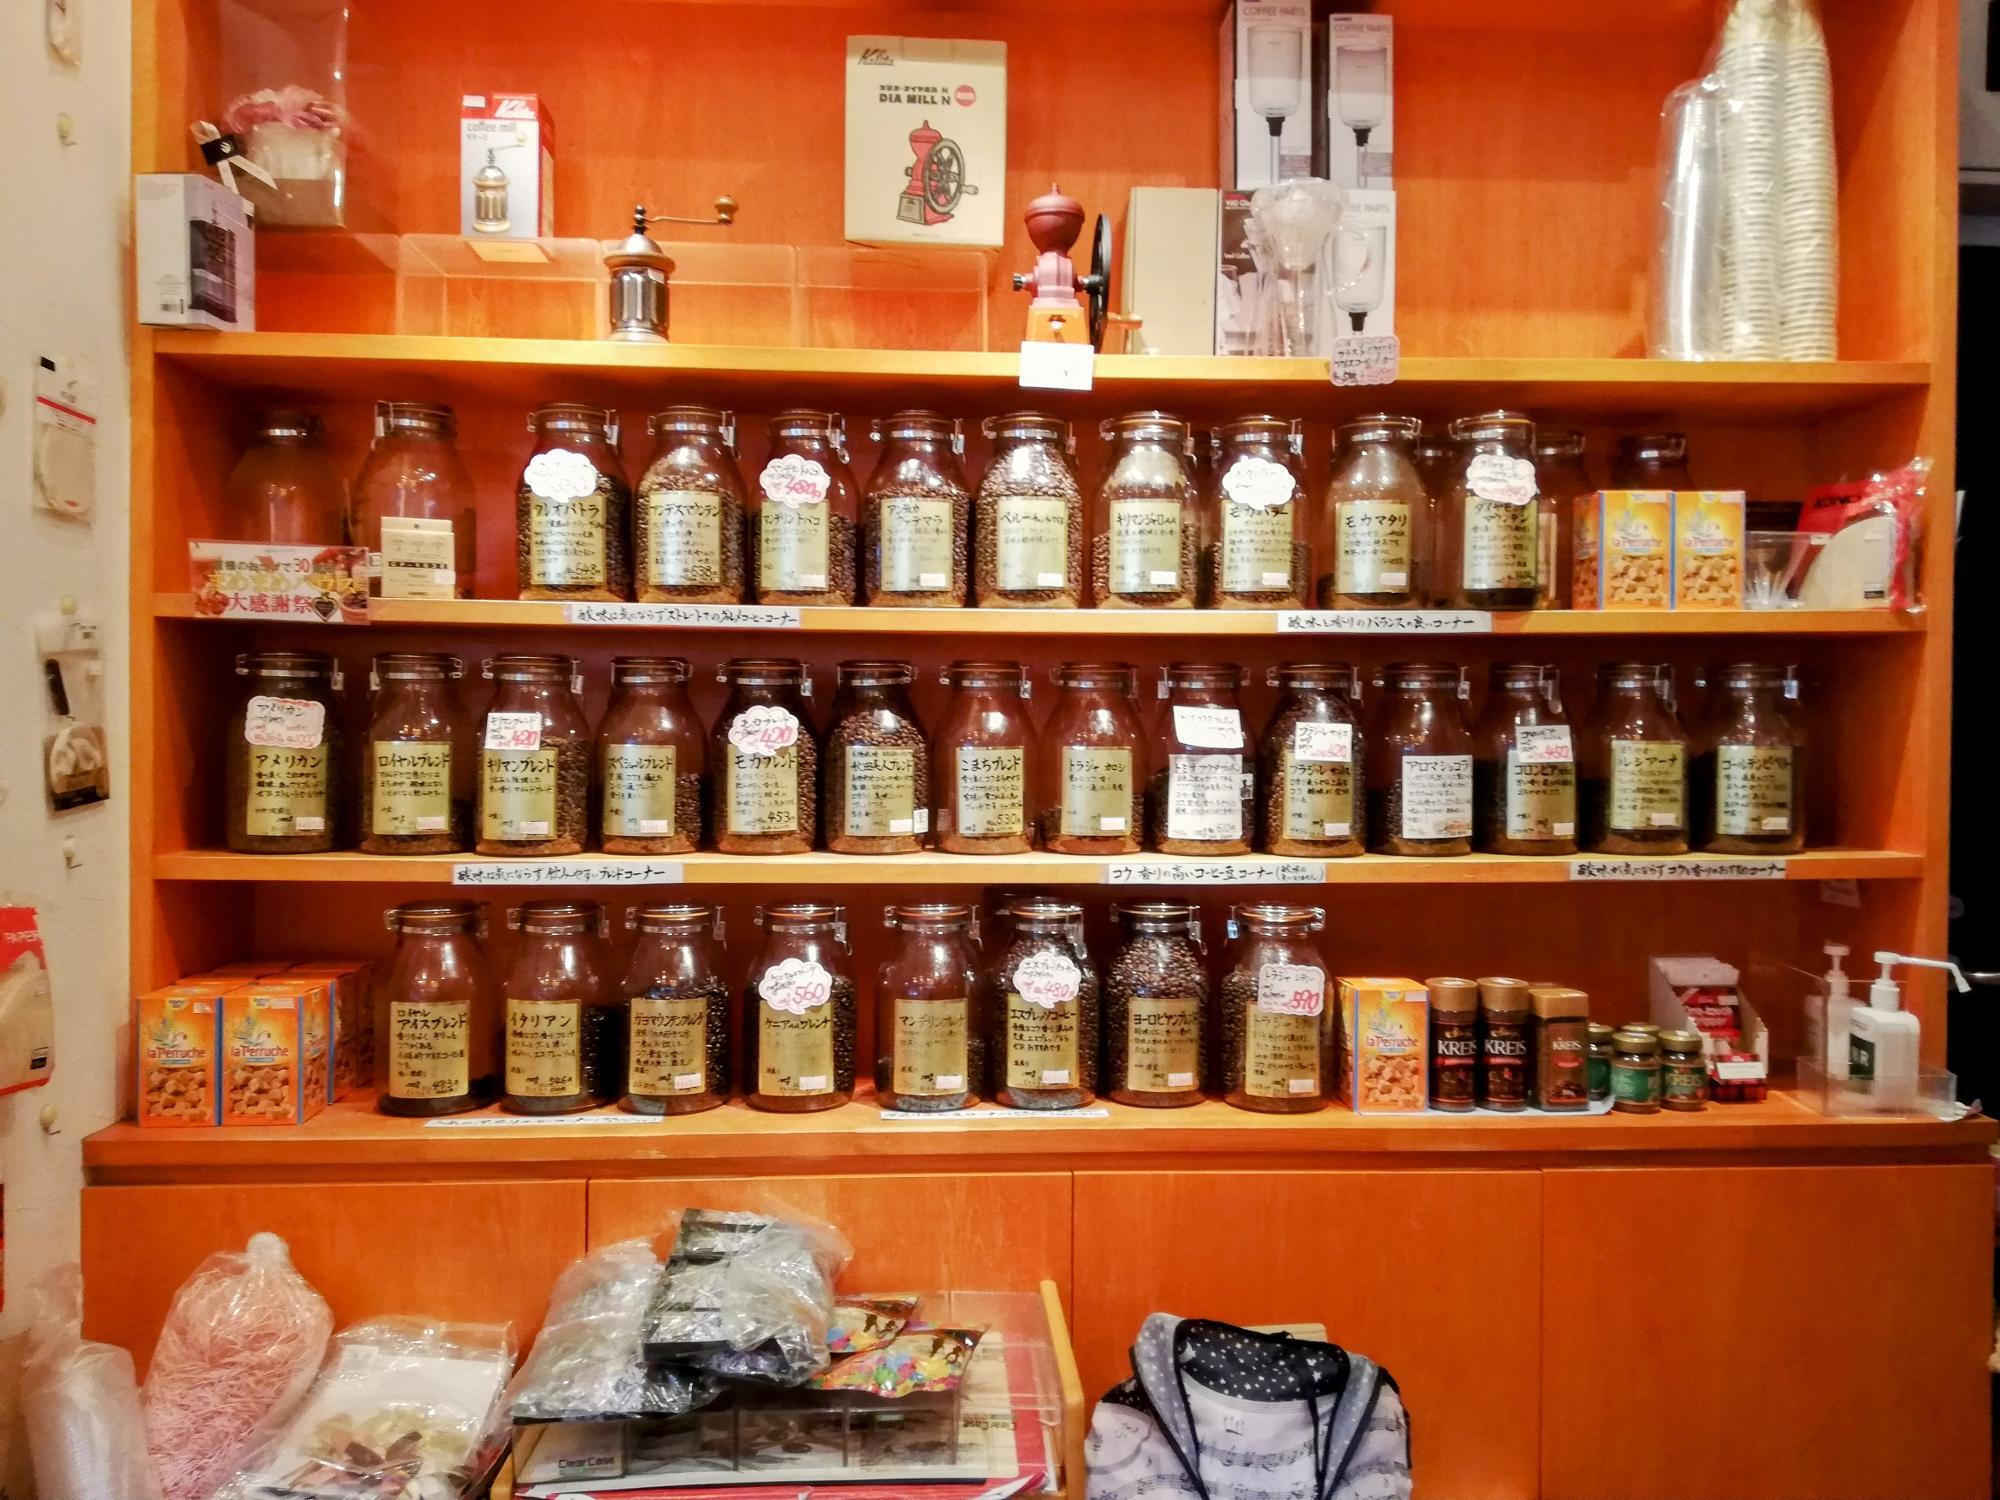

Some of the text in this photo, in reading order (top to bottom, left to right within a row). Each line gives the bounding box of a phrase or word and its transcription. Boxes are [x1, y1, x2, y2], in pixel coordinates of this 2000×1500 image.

[1243, 7, 1277, 16] COFFEE
[879, 93, 951, 105] DIA MILL N
[467, 122, 517, 132] coffee mill
[1364, 204, 1390, 213] PARTS
[228, 592, 313, 613] 大感謝祭
[256, 754, 323, 769] アメリカン
[378, 752, 451, 768] ロイヤルブレンド
[487, 756, 556, 773] キリマンブレンド
[735, 752, 798, 770] モカブレンド
[961, 755, 1022, 771] こまちブレンド
[1406, 760, 1471, 772] アロマショコラ
[793, 980, 825, 1005] 560
[397, 1012, 468, 1030] アイスブレンド
[511, 1011, 572, 1028] イタリアン
[1010, 1007, 1077, 1021] エスプレッソコーヒー
[1376, 1035, 1419, 1047] Perruche
[1484, 1040, 1527, 1055] KREIS
[1552, 1038, 1582, 1050] KREIS
[158, 1047, 206, 1058] Perruche
[241, 1045, 289, 1056] Perruche
